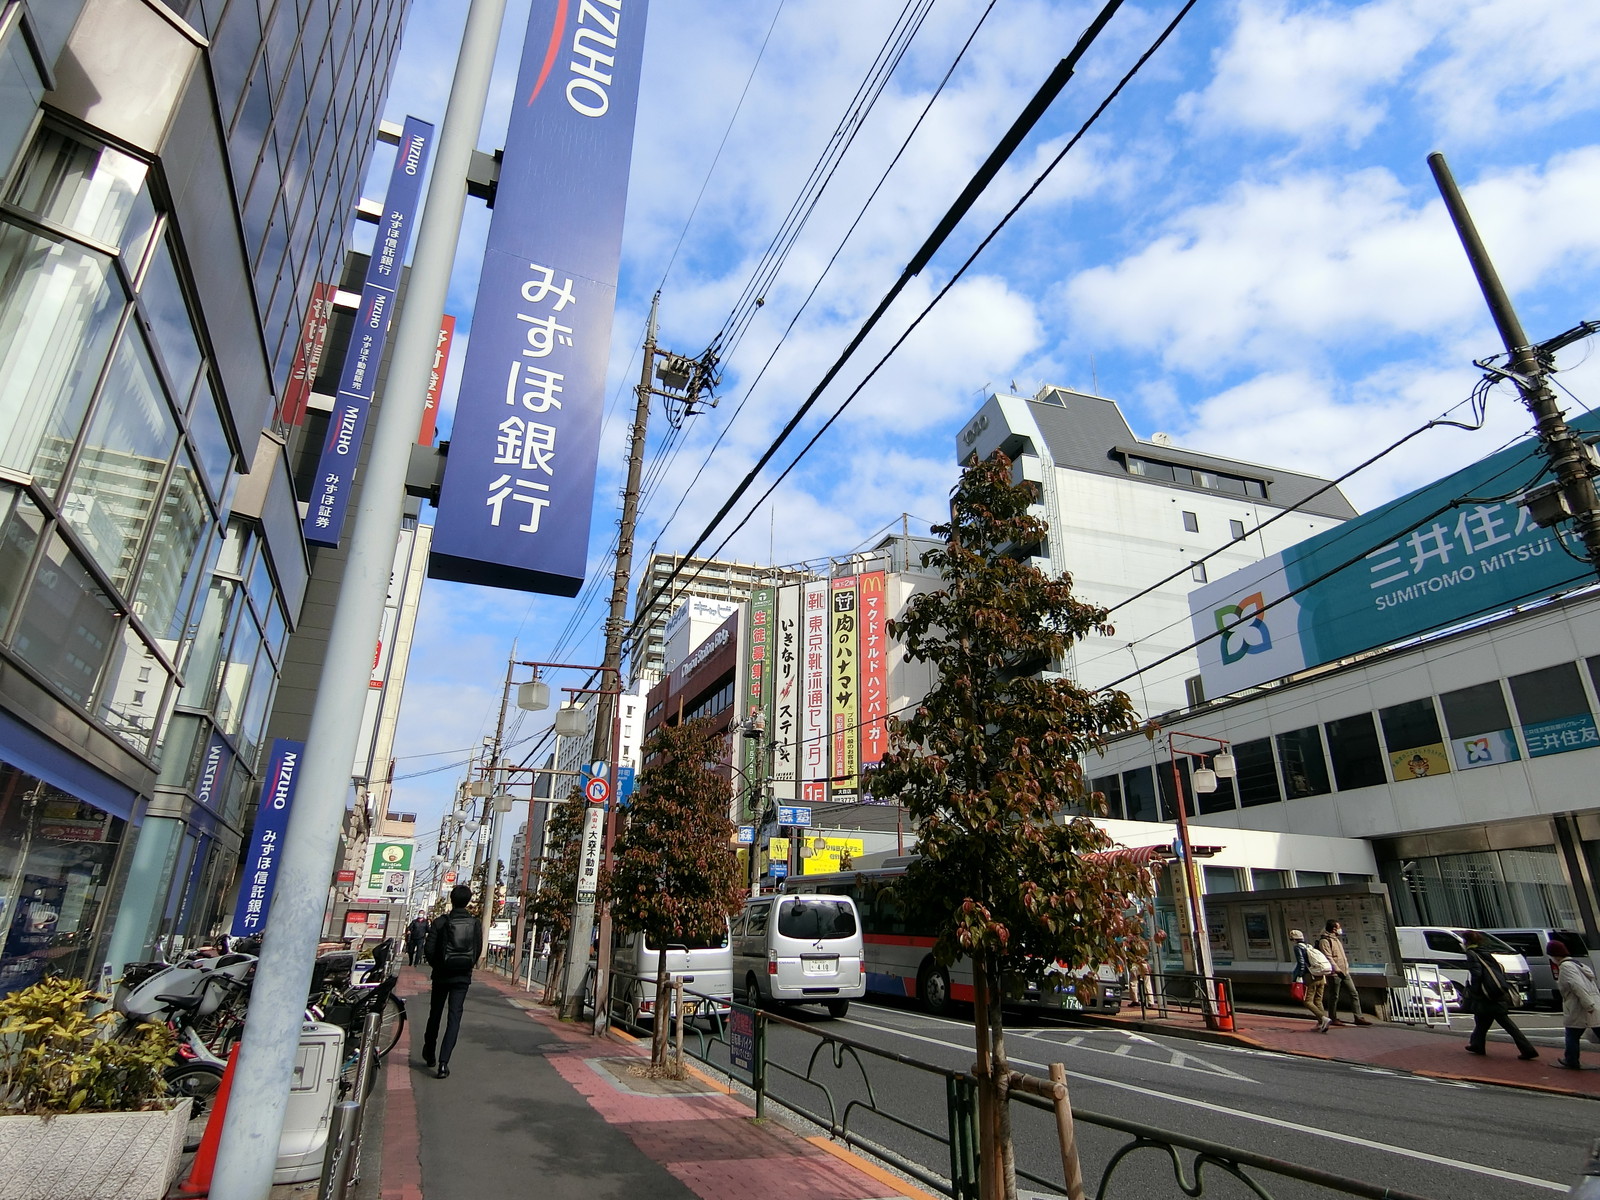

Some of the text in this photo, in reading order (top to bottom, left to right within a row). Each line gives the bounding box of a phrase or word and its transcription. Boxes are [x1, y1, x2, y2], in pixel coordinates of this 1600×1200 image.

[404, 134, 425, 176] MIZUHO
[378, 211, 403, 276] みずほ信託銀行
[369, 293, 387, 329] MIZUHO
[485, 262, 577, 533] みずほ銀行
[336, 405, 360, 455] MIZUHO
[315, 473, 340, 528] みずほ証券
[808, 592, 824, 610] 靴
[1375, 565, 1476, 611] SUMITOMO
[1481, 537, 1552, 575] MITSUI
[751, 610, 766, 698] 生徒募集中
[834, 613, 855, 709] 肉のハナマサ
[866, 597, 883, 754] マクドナルドハンバーガー
[807, 615, 824, 778] 東京靴流通センター
[1526, 726, 1599, 752] 三井住友
[273, 751, 297, 810] MIZUHO
[243, 829, 277, 928] みずほ信託銀行
[584, 830, 598, 877] 大森不動尊
